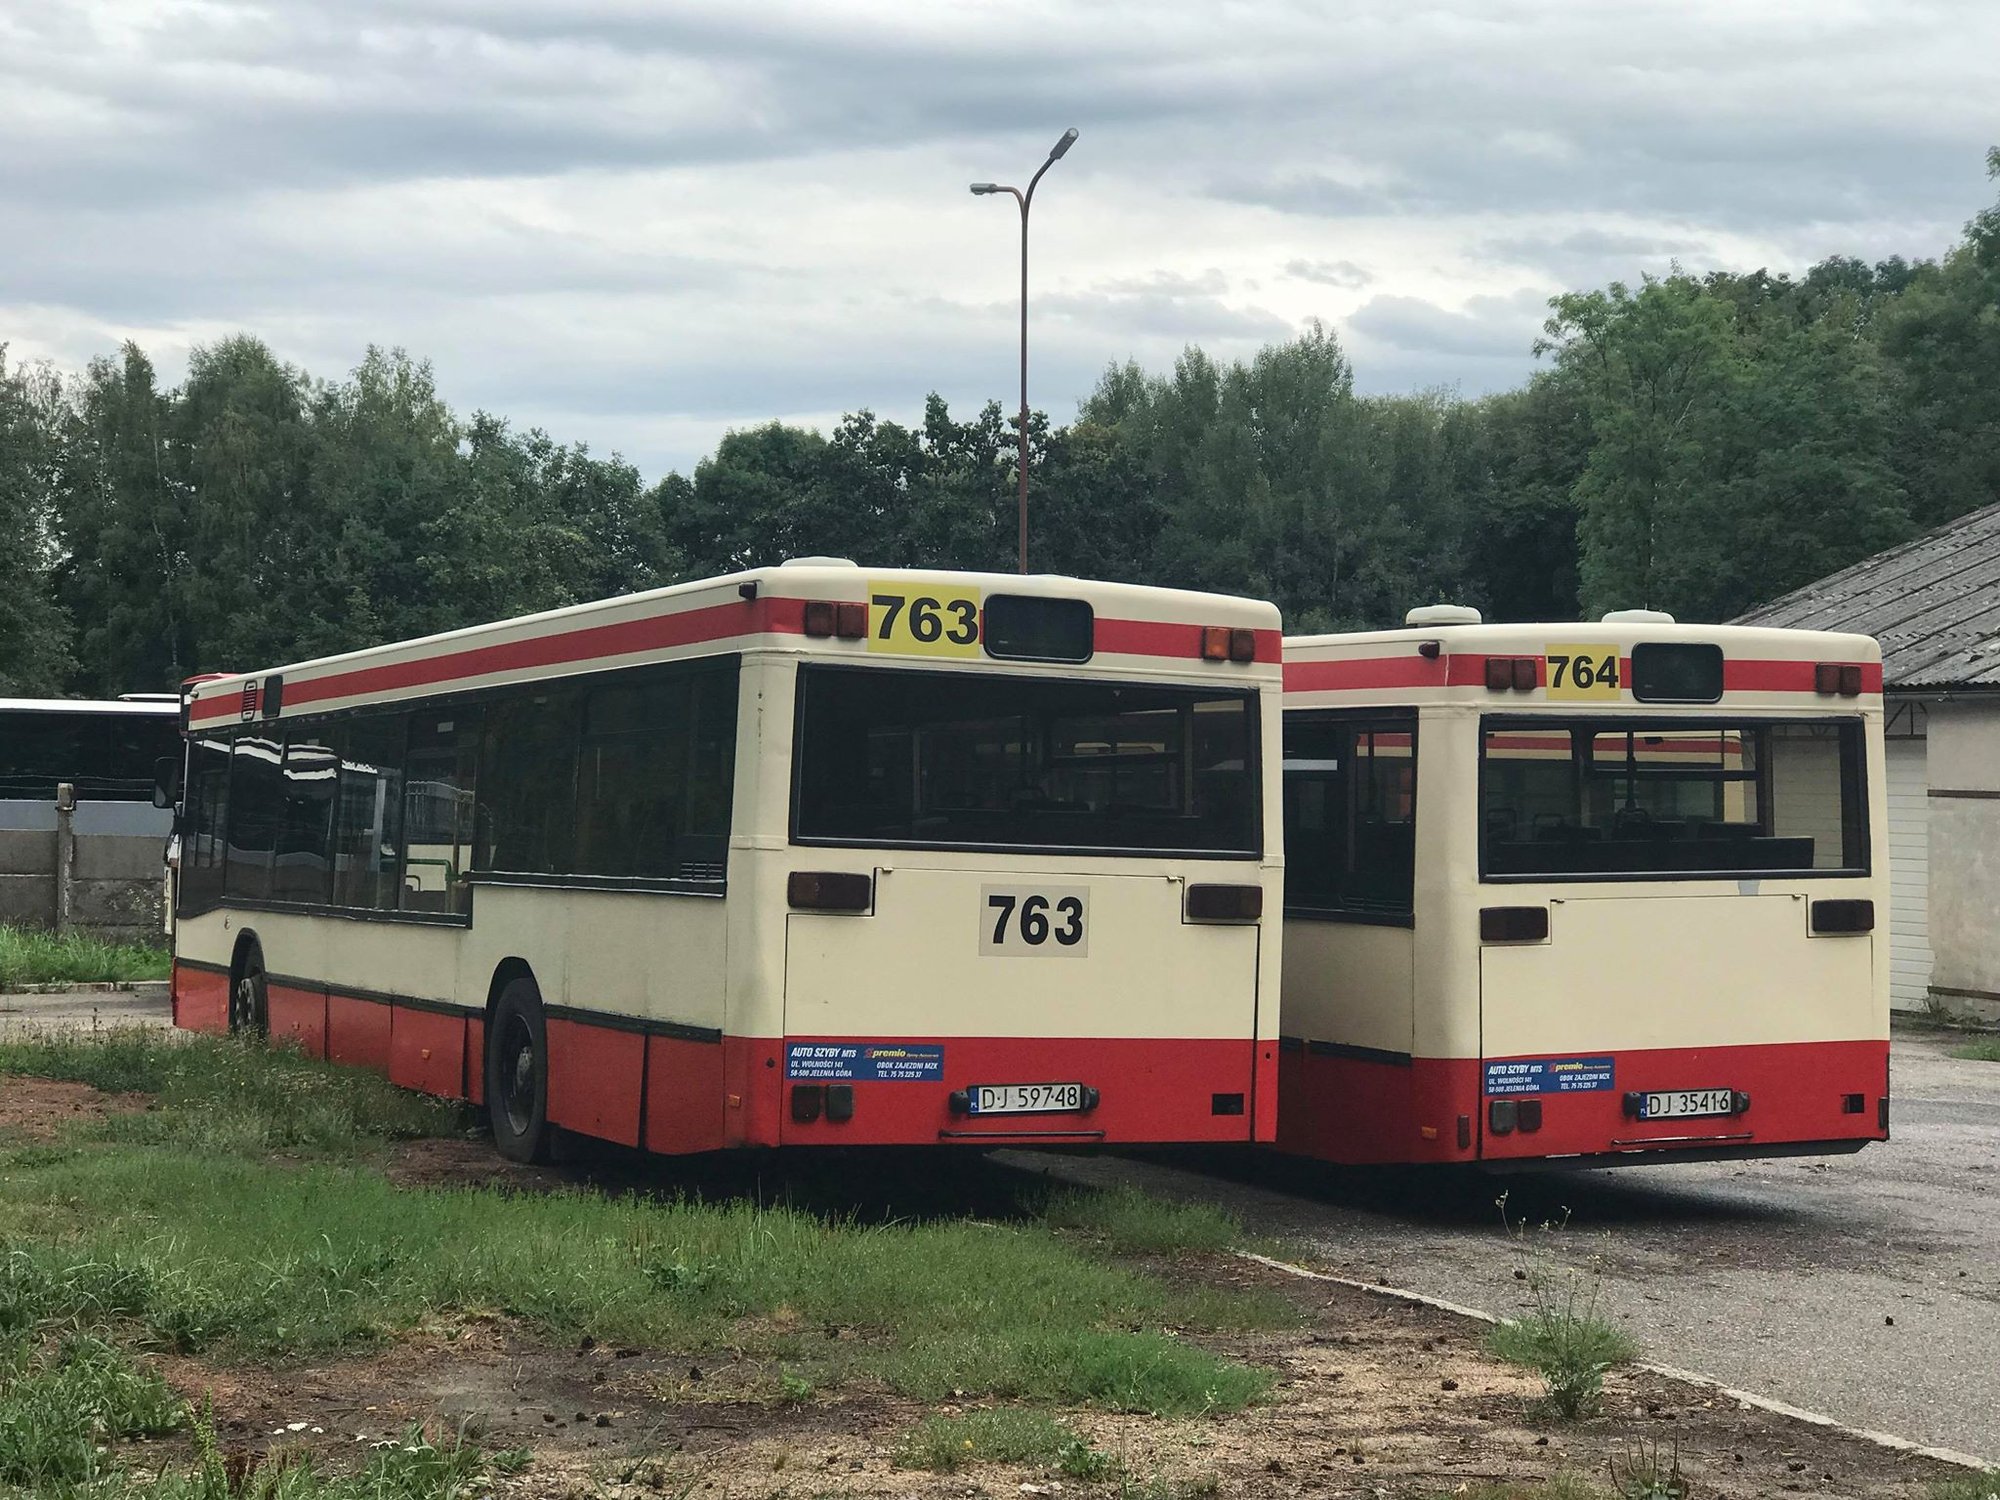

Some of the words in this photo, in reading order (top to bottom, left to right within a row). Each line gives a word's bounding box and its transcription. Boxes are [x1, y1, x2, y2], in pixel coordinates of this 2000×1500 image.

[872, 594, 978, 645] 763
[1547, 655, 1619, 689] 764
[989, 895, 1083, 945] 763
[791, 1047, 813, 1058] AUTO
[814, 1047, 841, 1058] SZYBY
[841, 1049, 857, 1058] MTS
[872, 1049, 906, 1058] premio
[801, 1060, 833, 1069] WOLNOŚCI
[876, 1061, 894, 1069] OBOK
[924, 1062, 938, 1070] MZK
[1488, 1065, 1507, 1075] AUTO
[1507, 1064, 1530, 1074] SZYBY
[1555, 1062, 1583, 1072] premio
[790, 1069, 810, 1077] 58-500
[809, 1069, 834, 1077] JELENIA
[835, 1068, 852, 1077] GÓRA
[982, 1088, 1008, 1109] DJ
[1018, 1086, 1078, 1107] 59748
[1649, 1095, 1671, 1115] DJ
[1680, 1092, 1728, 1113] 35416
